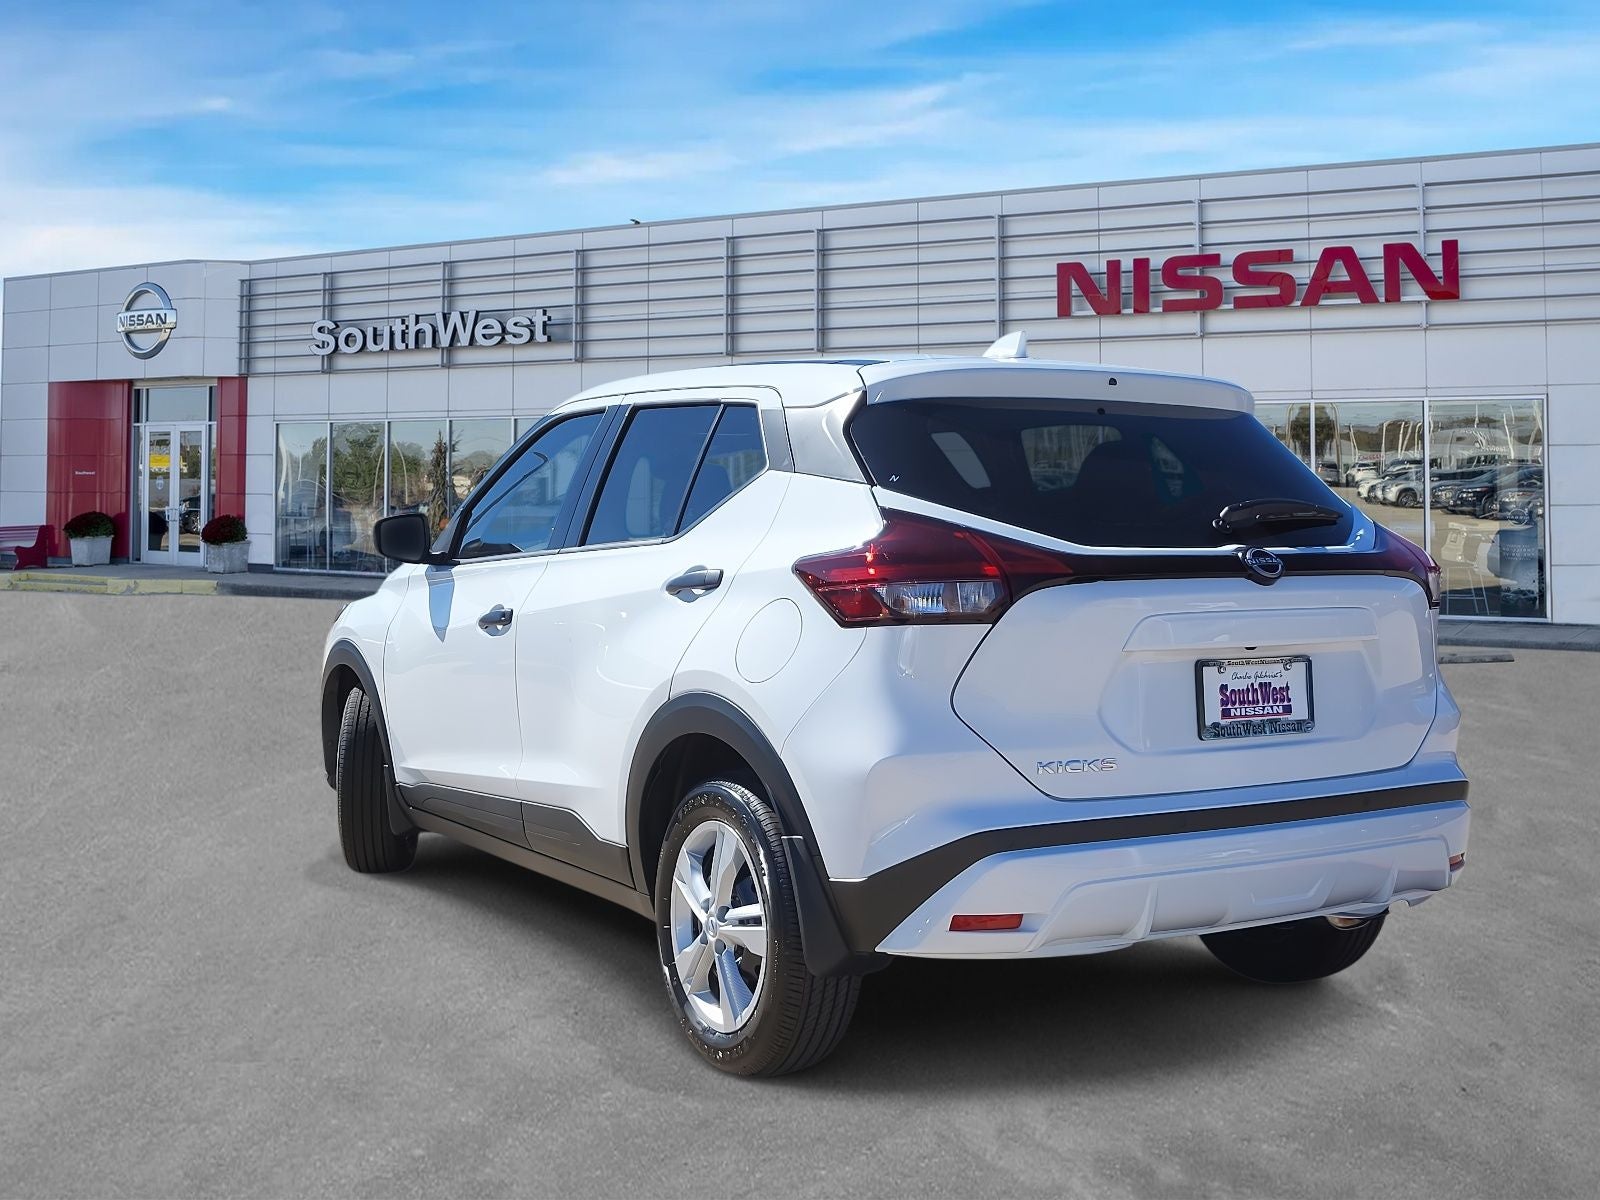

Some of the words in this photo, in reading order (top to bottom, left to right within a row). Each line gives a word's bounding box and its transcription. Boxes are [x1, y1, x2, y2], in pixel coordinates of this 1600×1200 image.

[1057, 239, 1460, 318] NISSAN
[119, 312, 168, 328] NISSAN
[308, 308, 552, 356] SouthWest
[1219, 681, 1292, 708] SouthWest
[1230, 705, 1284, 717] NISSAN
[1212, 719, 1267, 738] SouthWest
[1268, 718, 1304, 734] Nissan
[1036, 757, 1118, 775] KICKS
